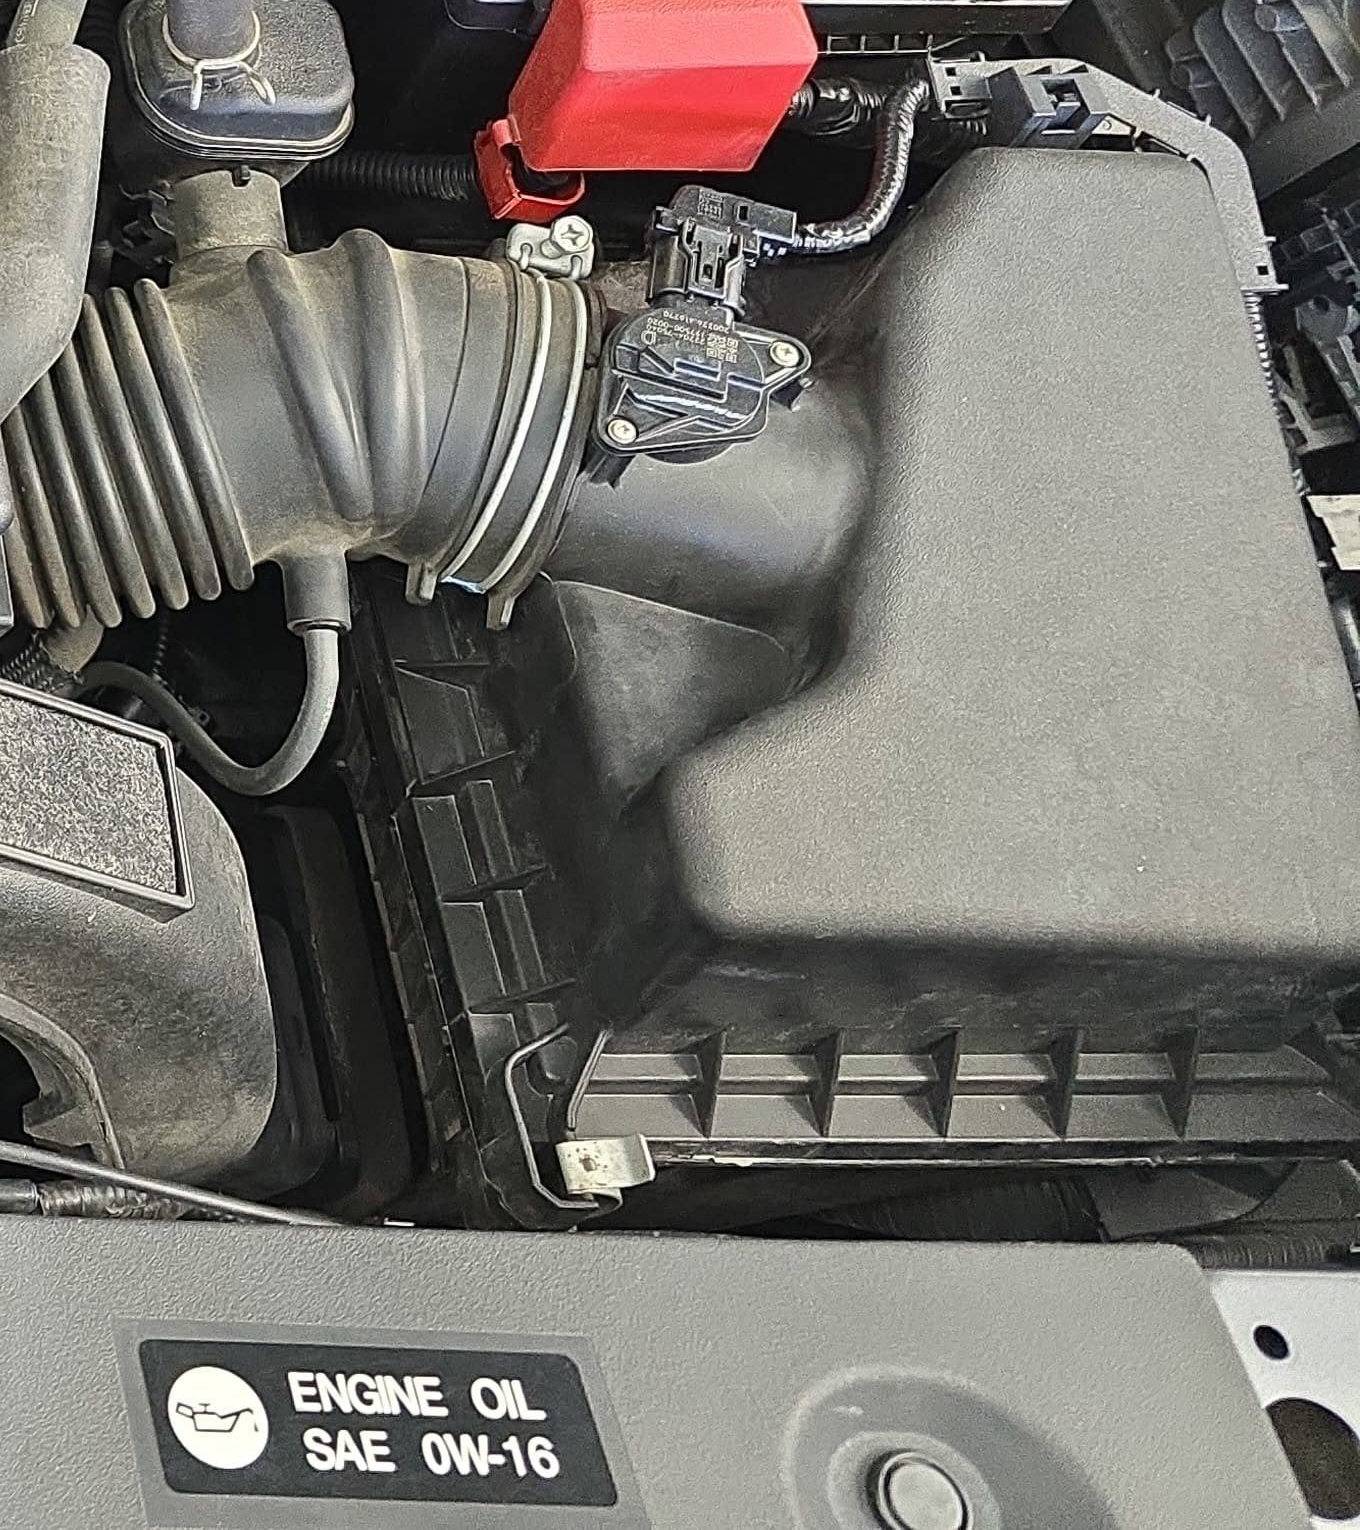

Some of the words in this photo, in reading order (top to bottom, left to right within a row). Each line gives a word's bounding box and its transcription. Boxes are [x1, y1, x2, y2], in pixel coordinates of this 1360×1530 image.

[287, 1371, 449, 1417] ENGINE
[470, 1377, 547, 1421] OIL
[302, 1427, 398, 1472] SAE
[421, 1431, 560, 1479] 0W-16
